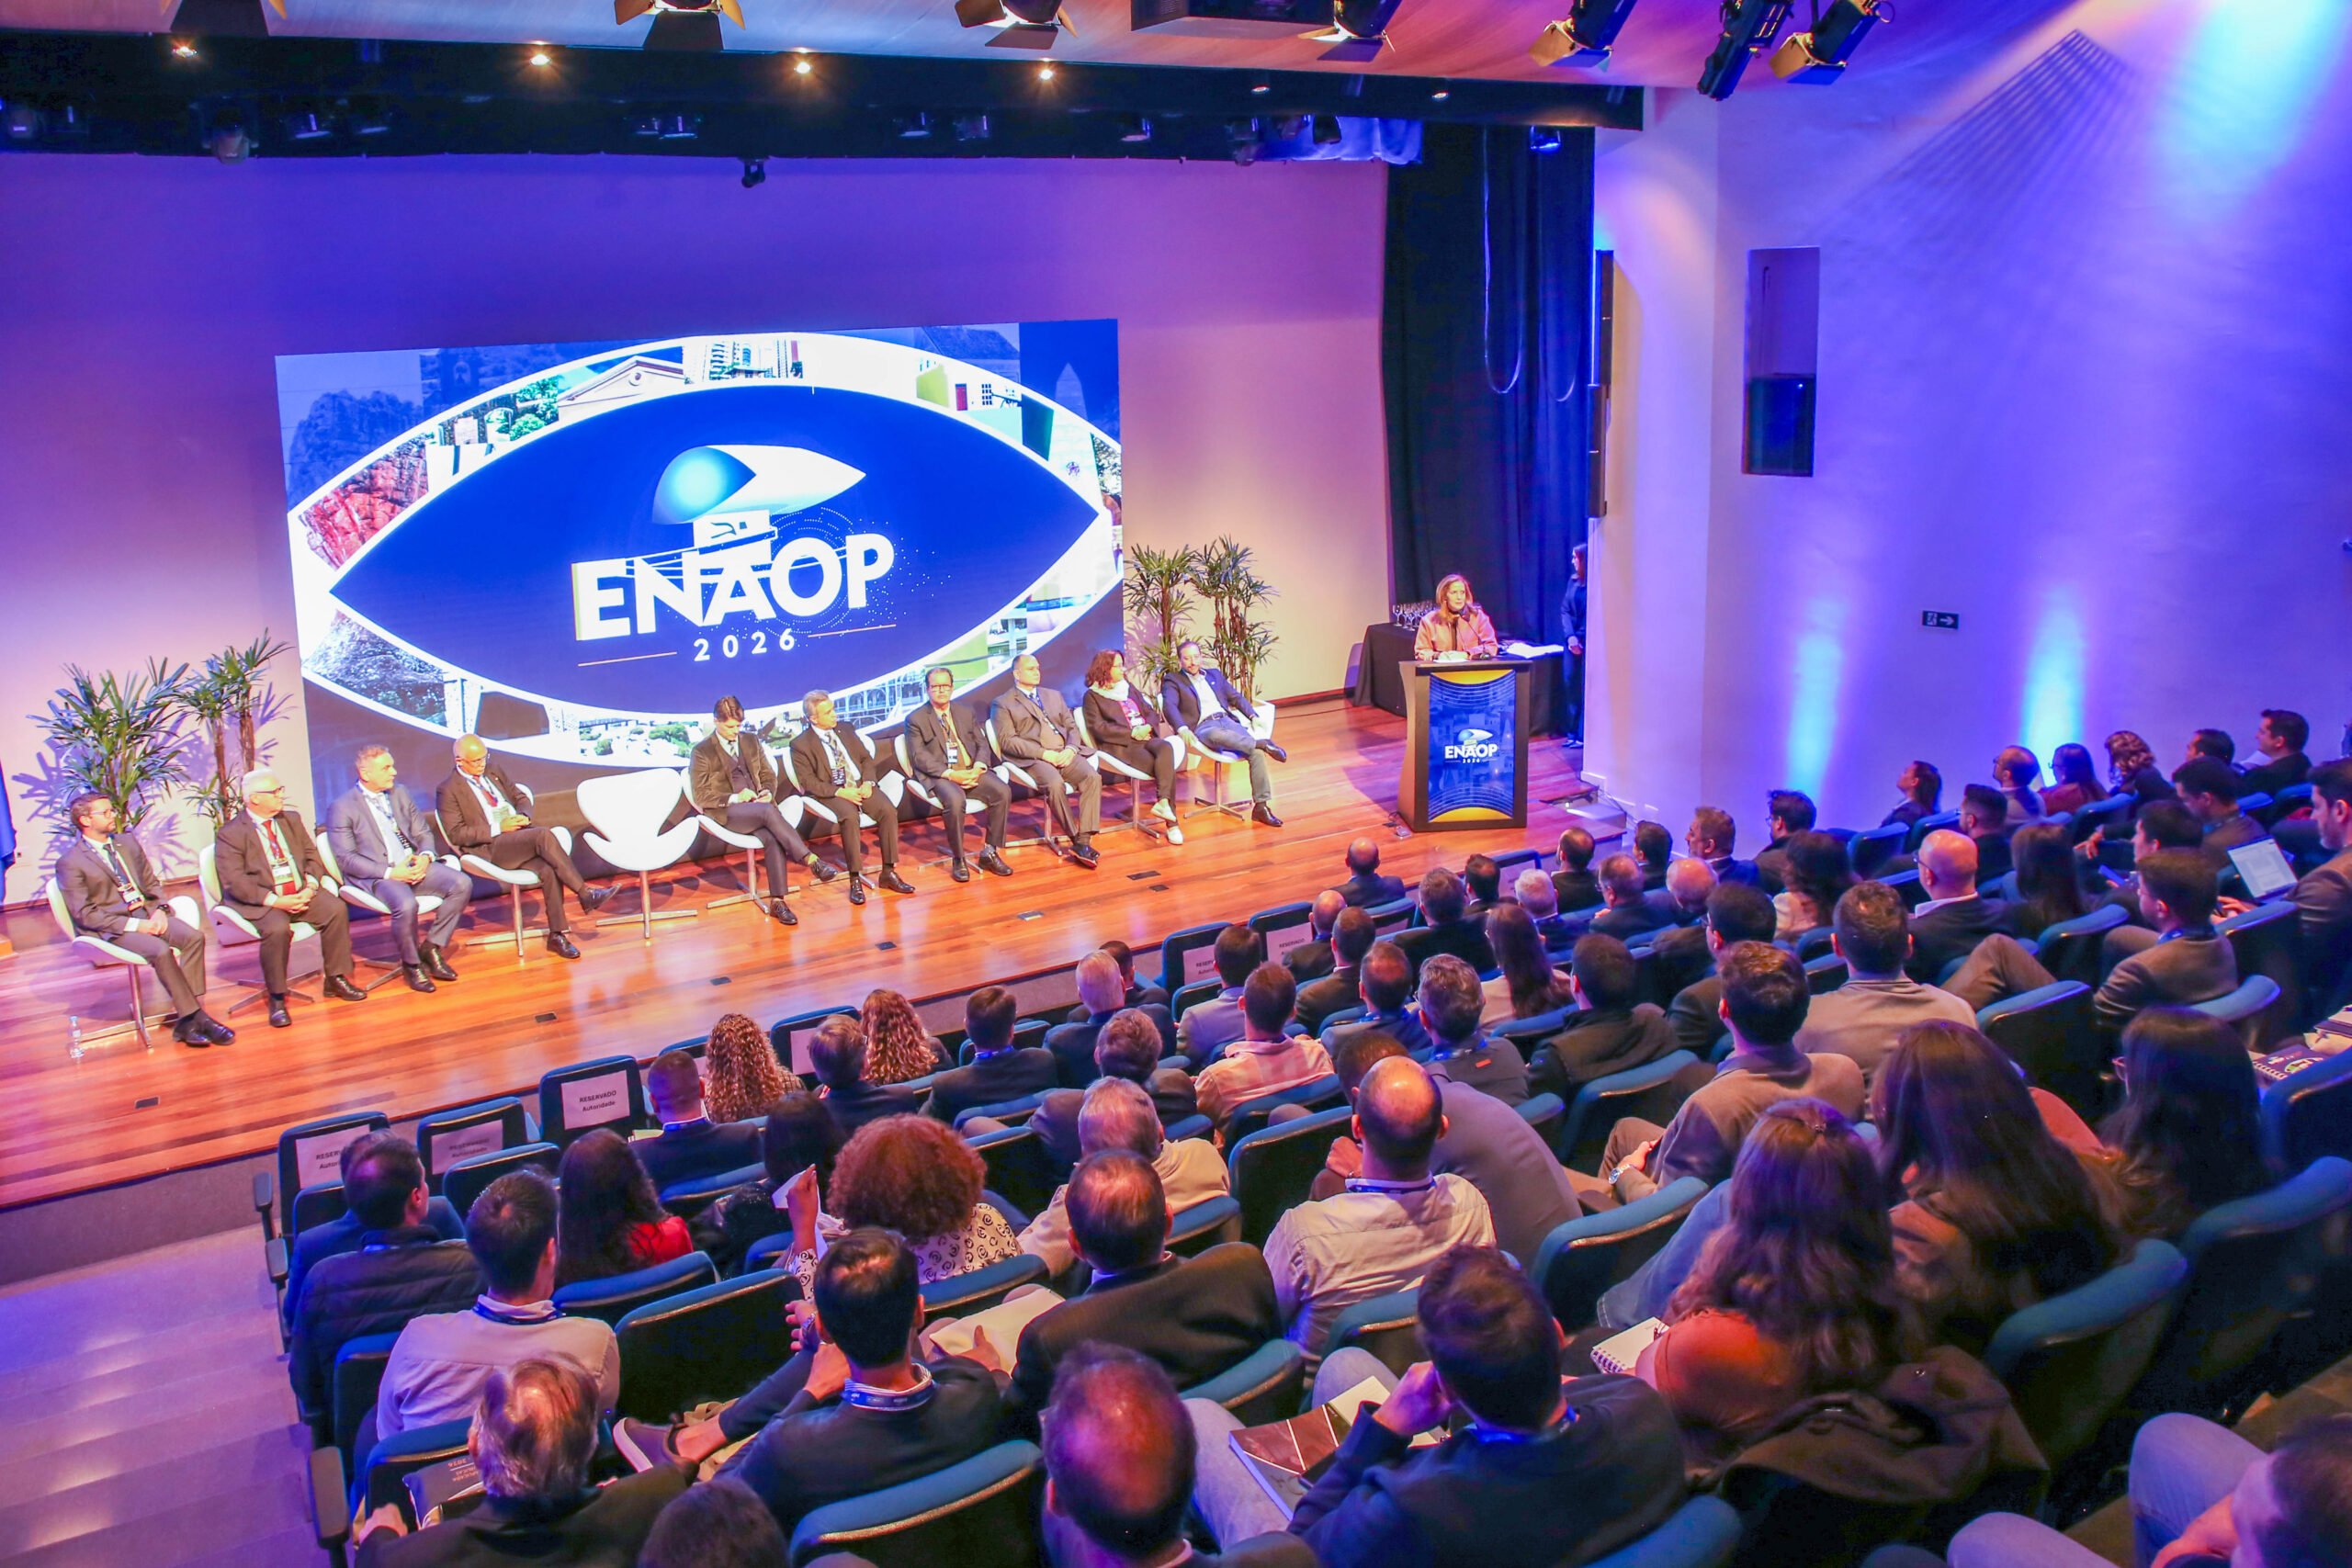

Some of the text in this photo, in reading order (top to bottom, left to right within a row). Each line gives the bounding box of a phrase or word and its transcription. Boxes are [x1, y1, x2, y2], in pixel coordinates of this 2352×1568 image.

[571, 533, 895, 641] ENAOP
[694, 628, 796, 661] 2026
[1444, 743, 1498, 759] ENAOP
[579, 1090, 616, 1103] RESERVADO
[582, 1100, 616, 1112] Autoridade
